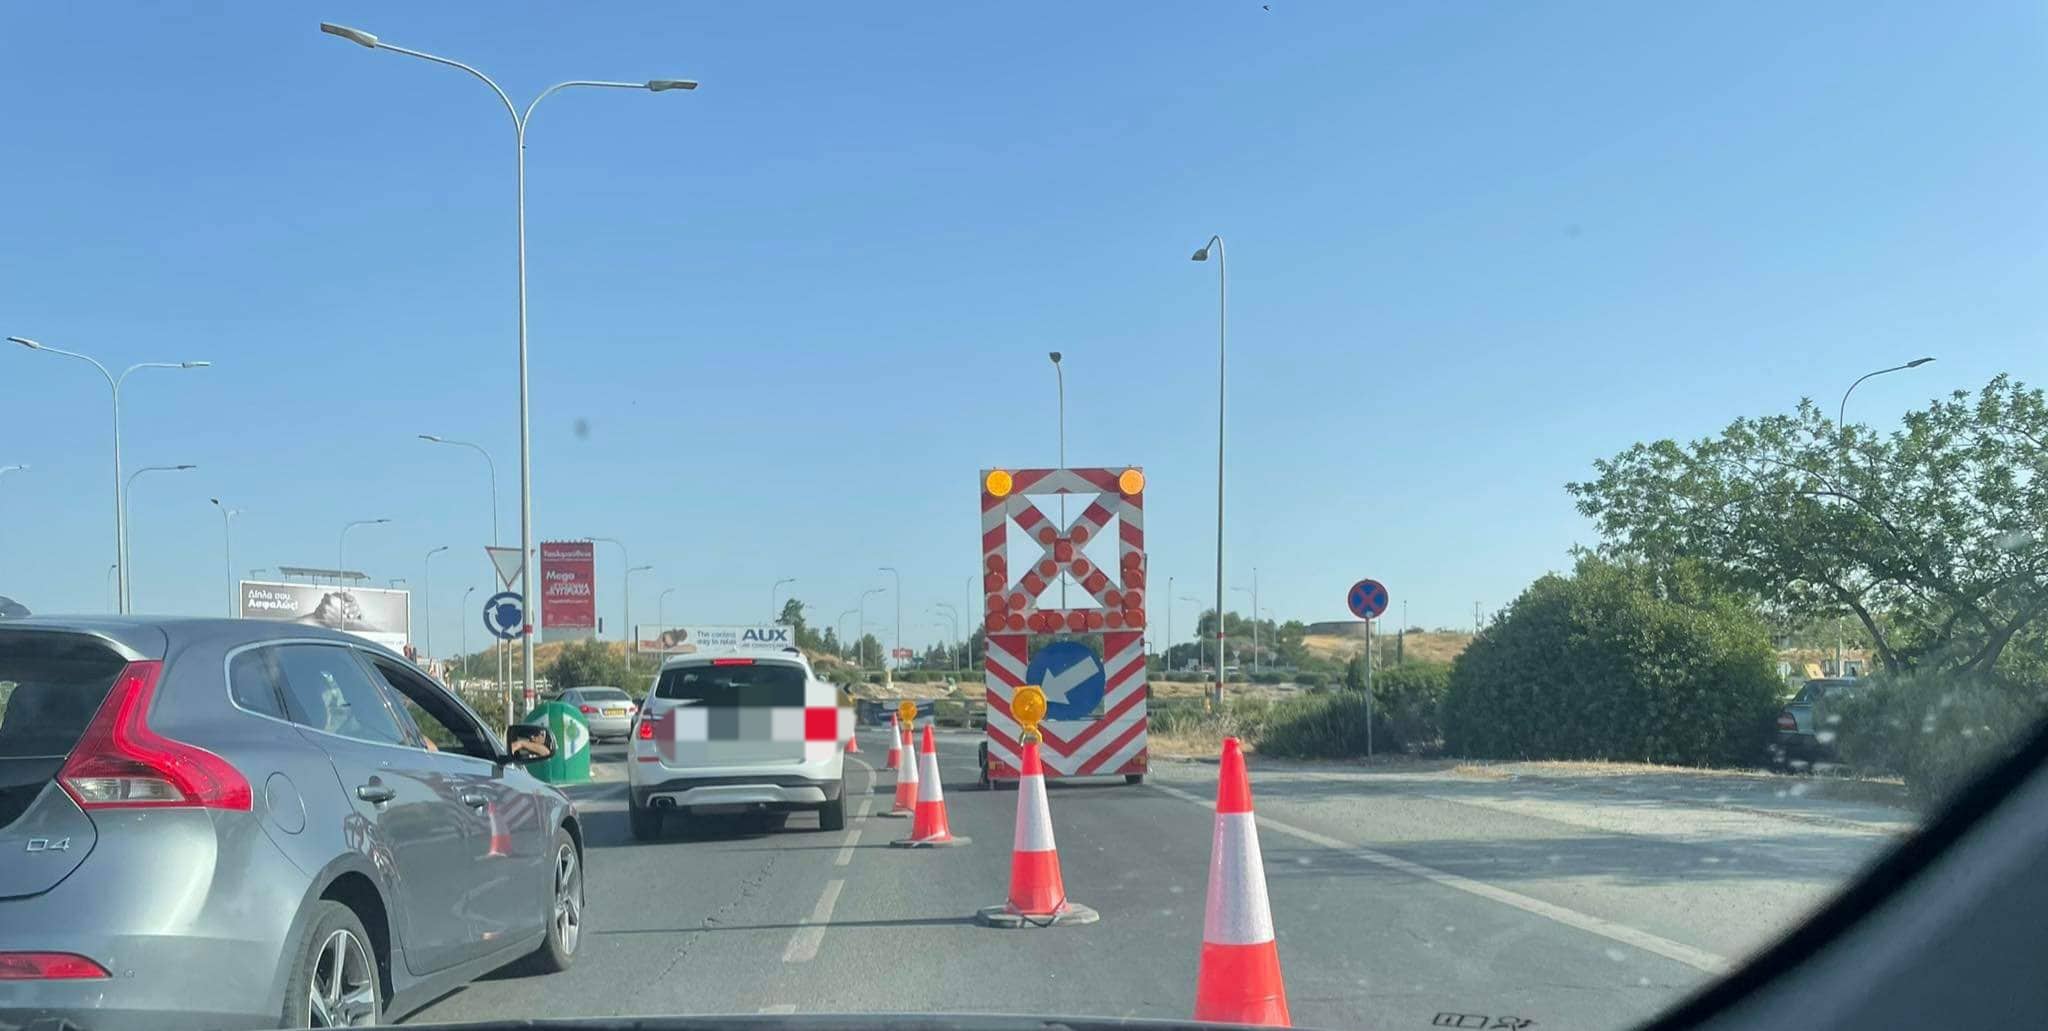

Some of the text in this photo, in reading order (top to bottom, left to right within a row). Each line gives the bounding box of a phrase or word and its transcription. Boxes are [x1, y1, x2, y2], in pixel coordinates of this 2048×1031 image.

[248, 589, 272, 600] Δίπλα
[248, 598, 298, 611] Ασφαλώς!
[697, 630, 710, 638] The
[742, 628, 788, 642] AUX
[27, 837, 70, 850] D4
